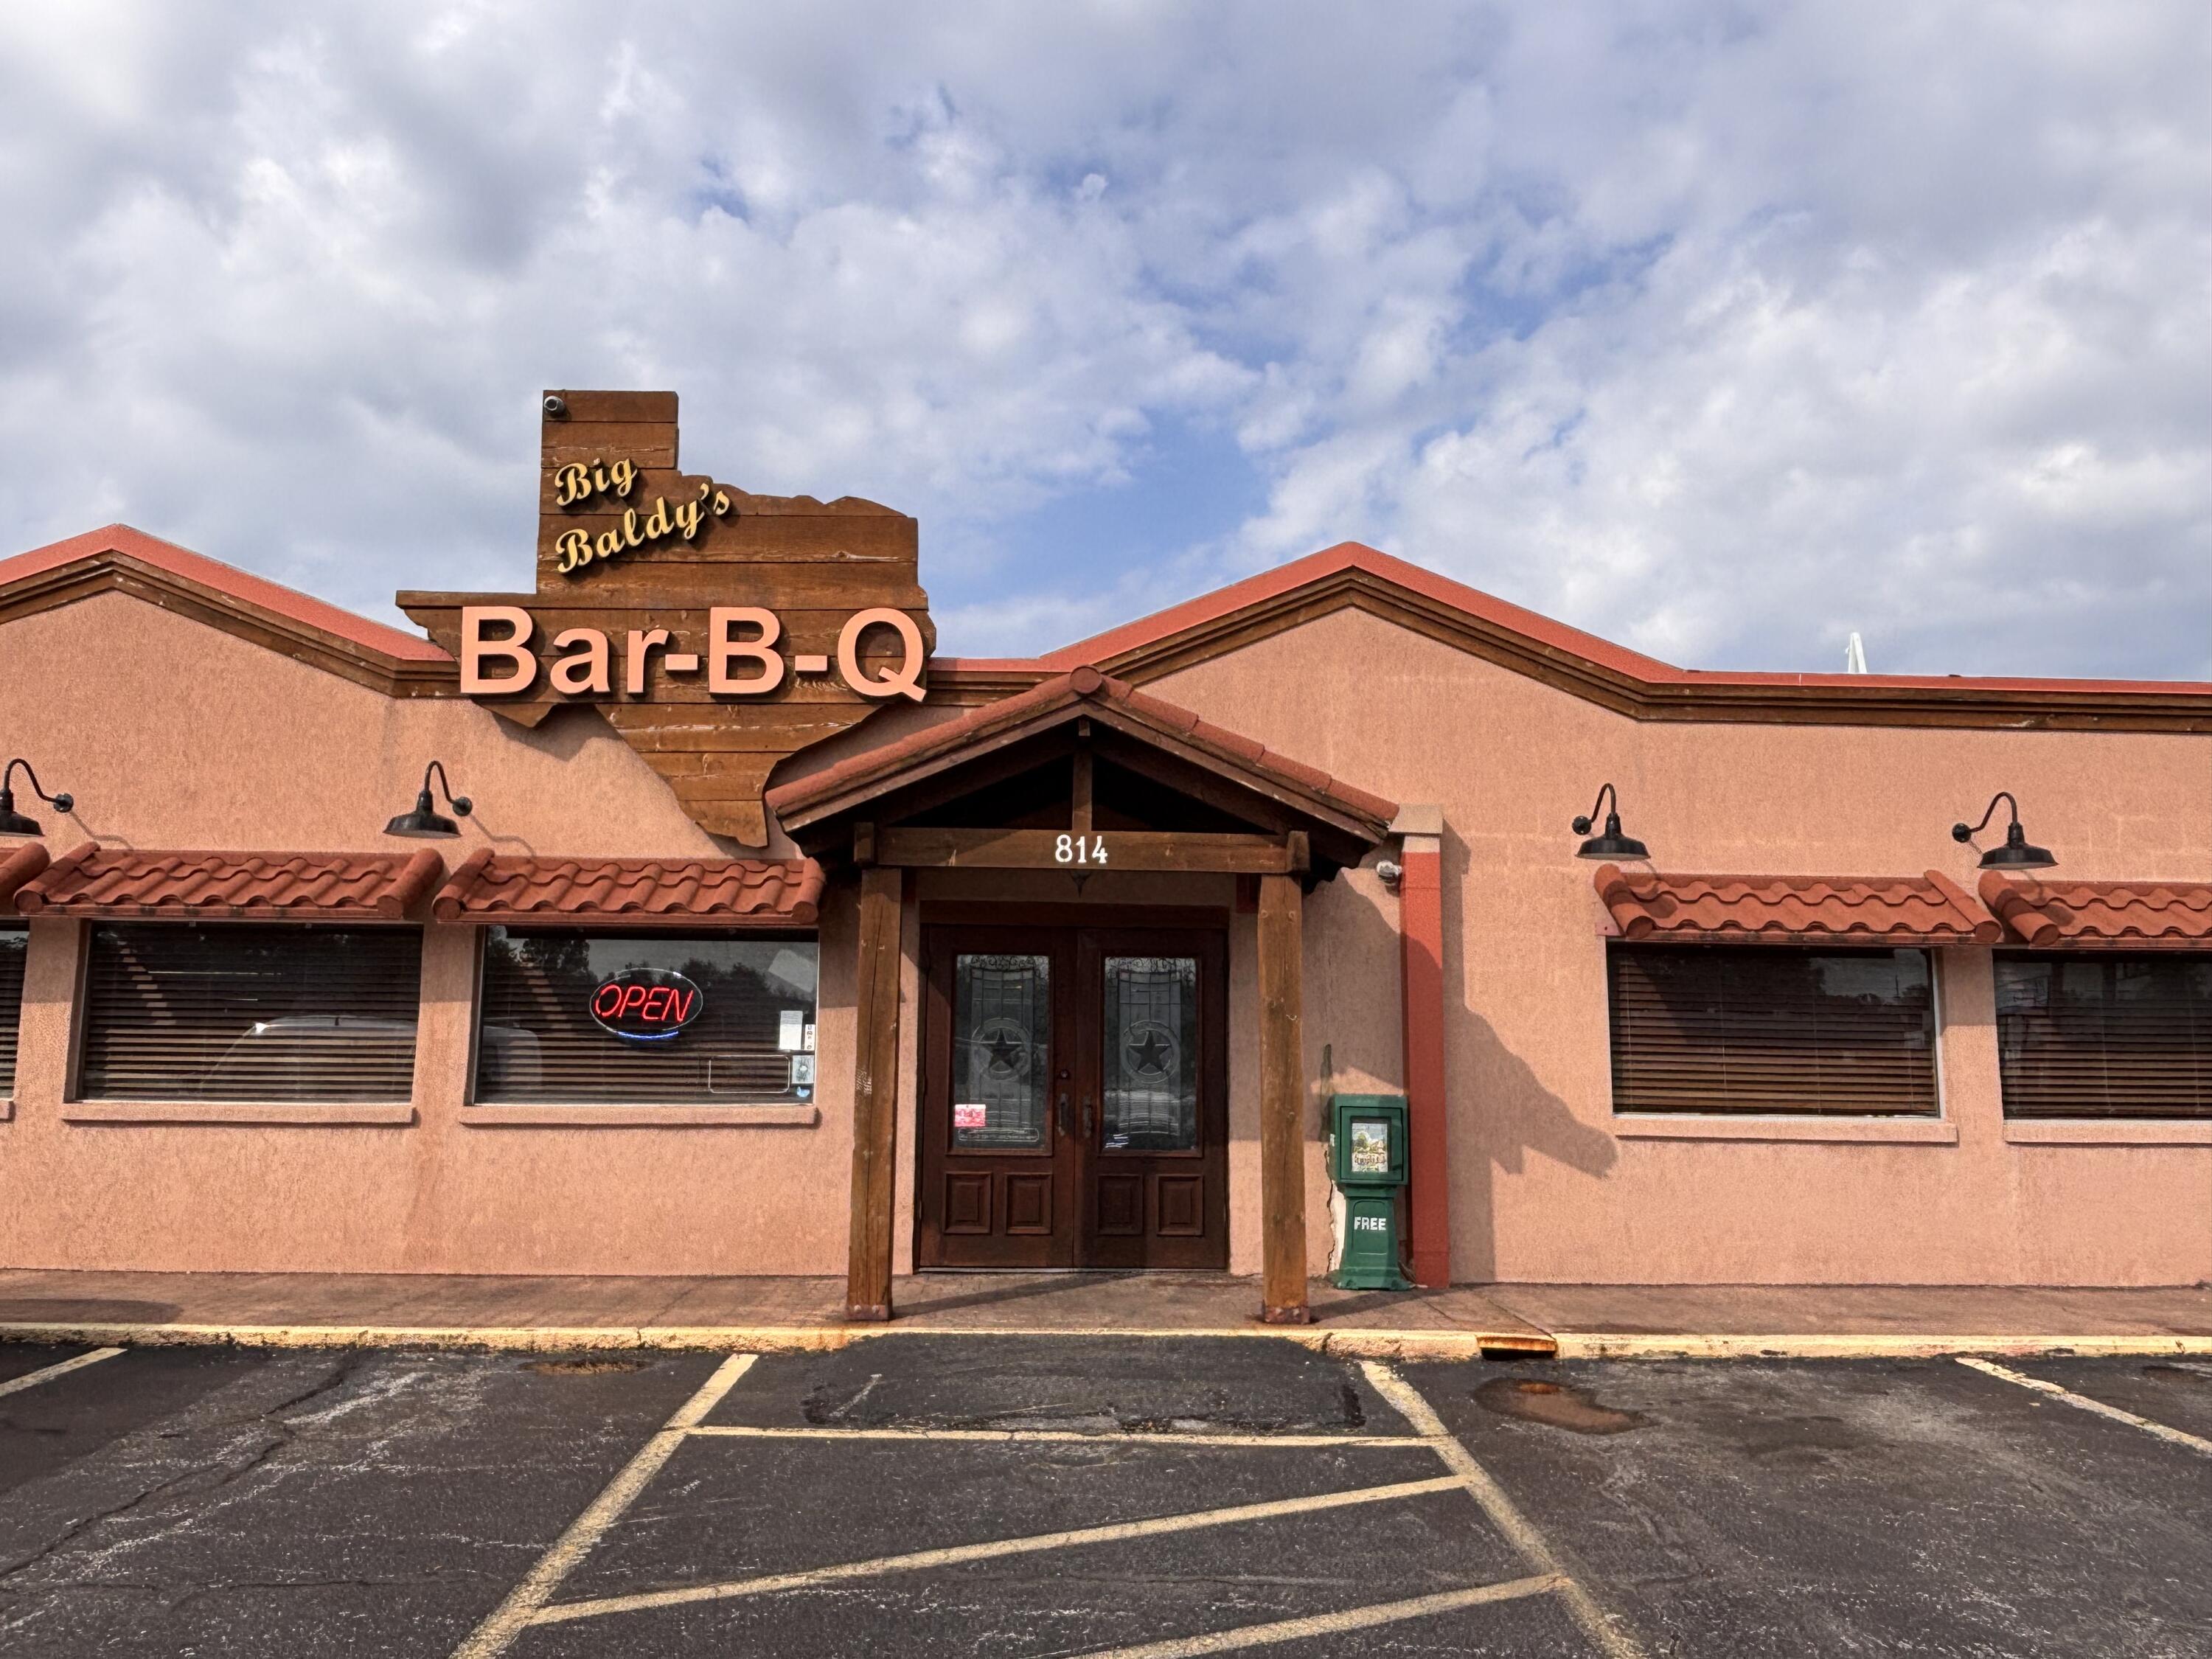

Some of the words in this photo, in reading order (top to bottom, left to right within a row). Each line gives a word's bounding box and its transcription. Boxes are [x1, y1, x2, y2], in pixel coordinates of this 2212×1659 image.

[554, 458, 637, 507] Big
[555, 483, 730, 573] Baldy's
[460, 606, 926, 701] Bar-B-Q
[1055, 834, 1108, 863] 814
[595, 984, 695, 1023] OPEN
[1354, 1217, 1387, 1231] FREE
